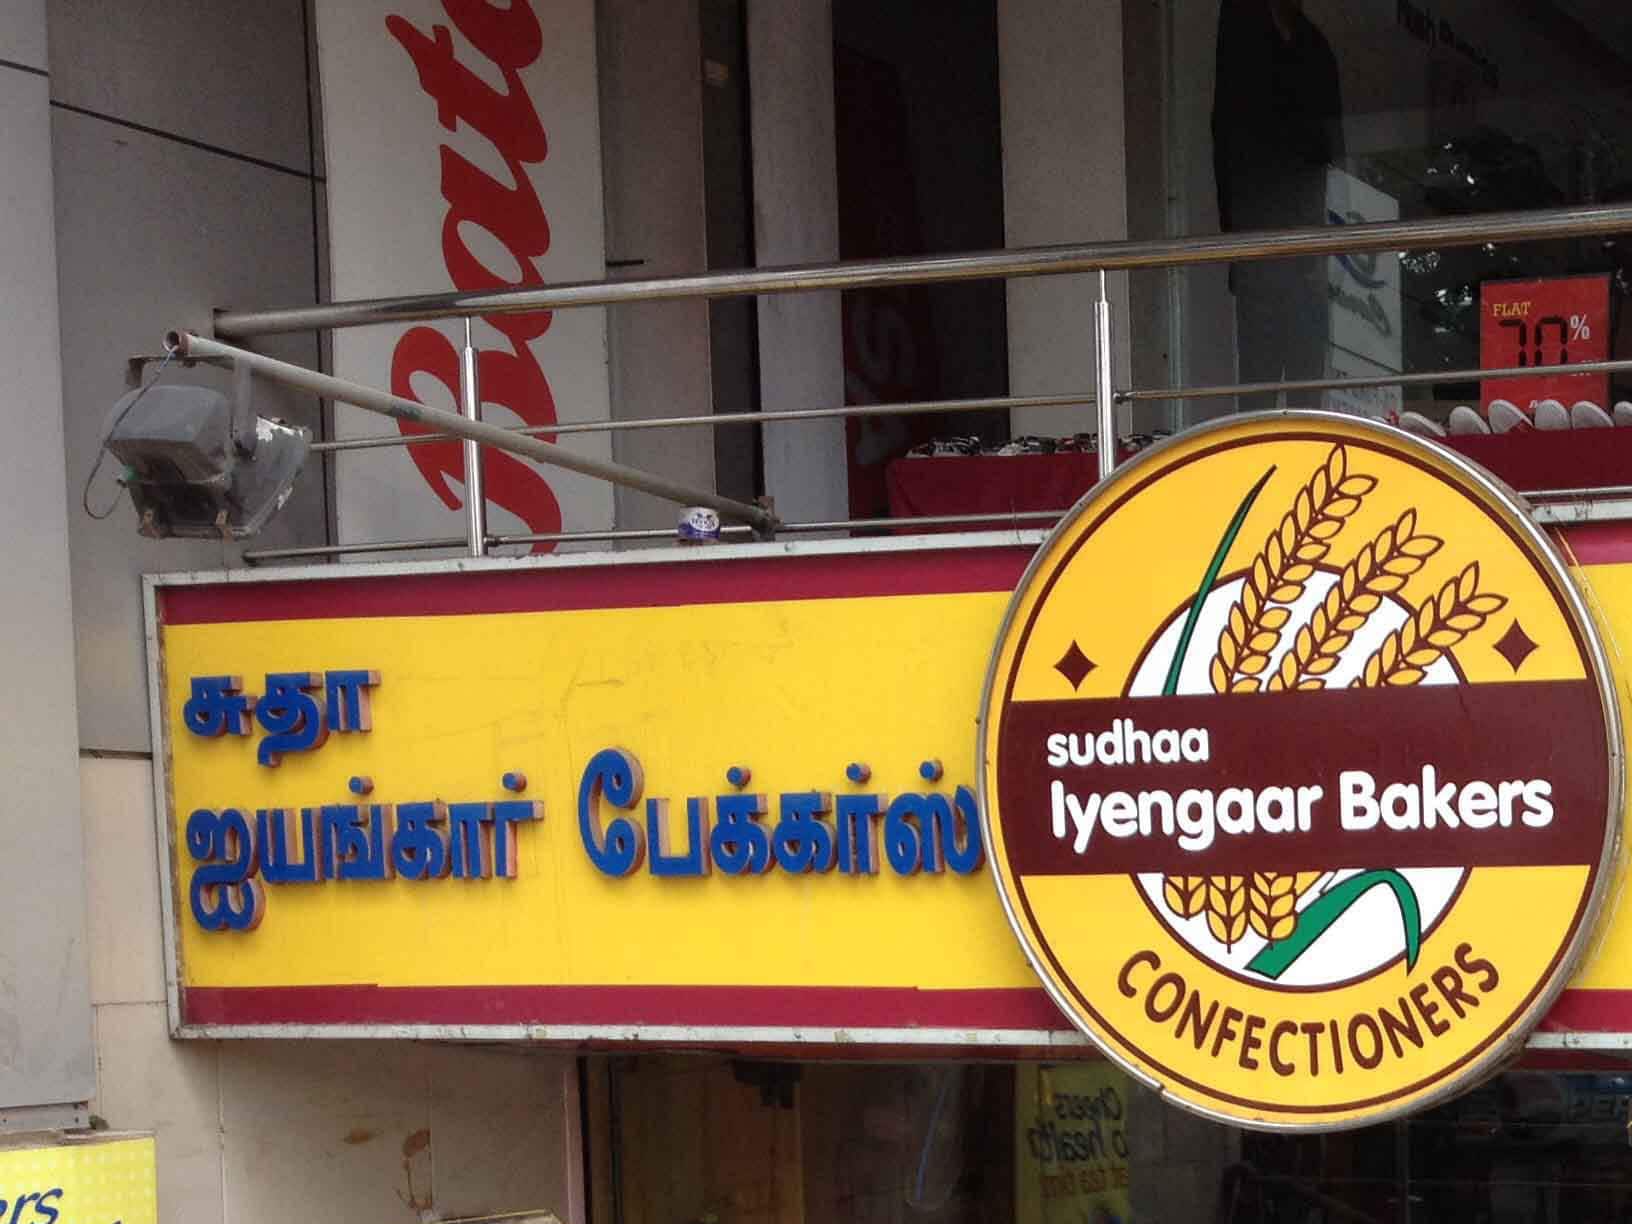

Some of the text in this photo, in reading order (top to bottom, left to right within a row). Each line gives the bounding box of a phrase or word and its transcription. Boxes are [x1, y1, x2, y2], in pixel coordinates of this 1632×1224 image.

[1493, 302, 1530, 316] FLAT
[184, 669, 374, 766] சுதா
[1047, 719, 1209, 766] sudhaa
[186, 772, 540, 932] ஐயங்கார்
[1051, 764, 1554, 853] Iyengaar Bakers
[1117, 941, 1500, 1077] CONFECTIONERS
